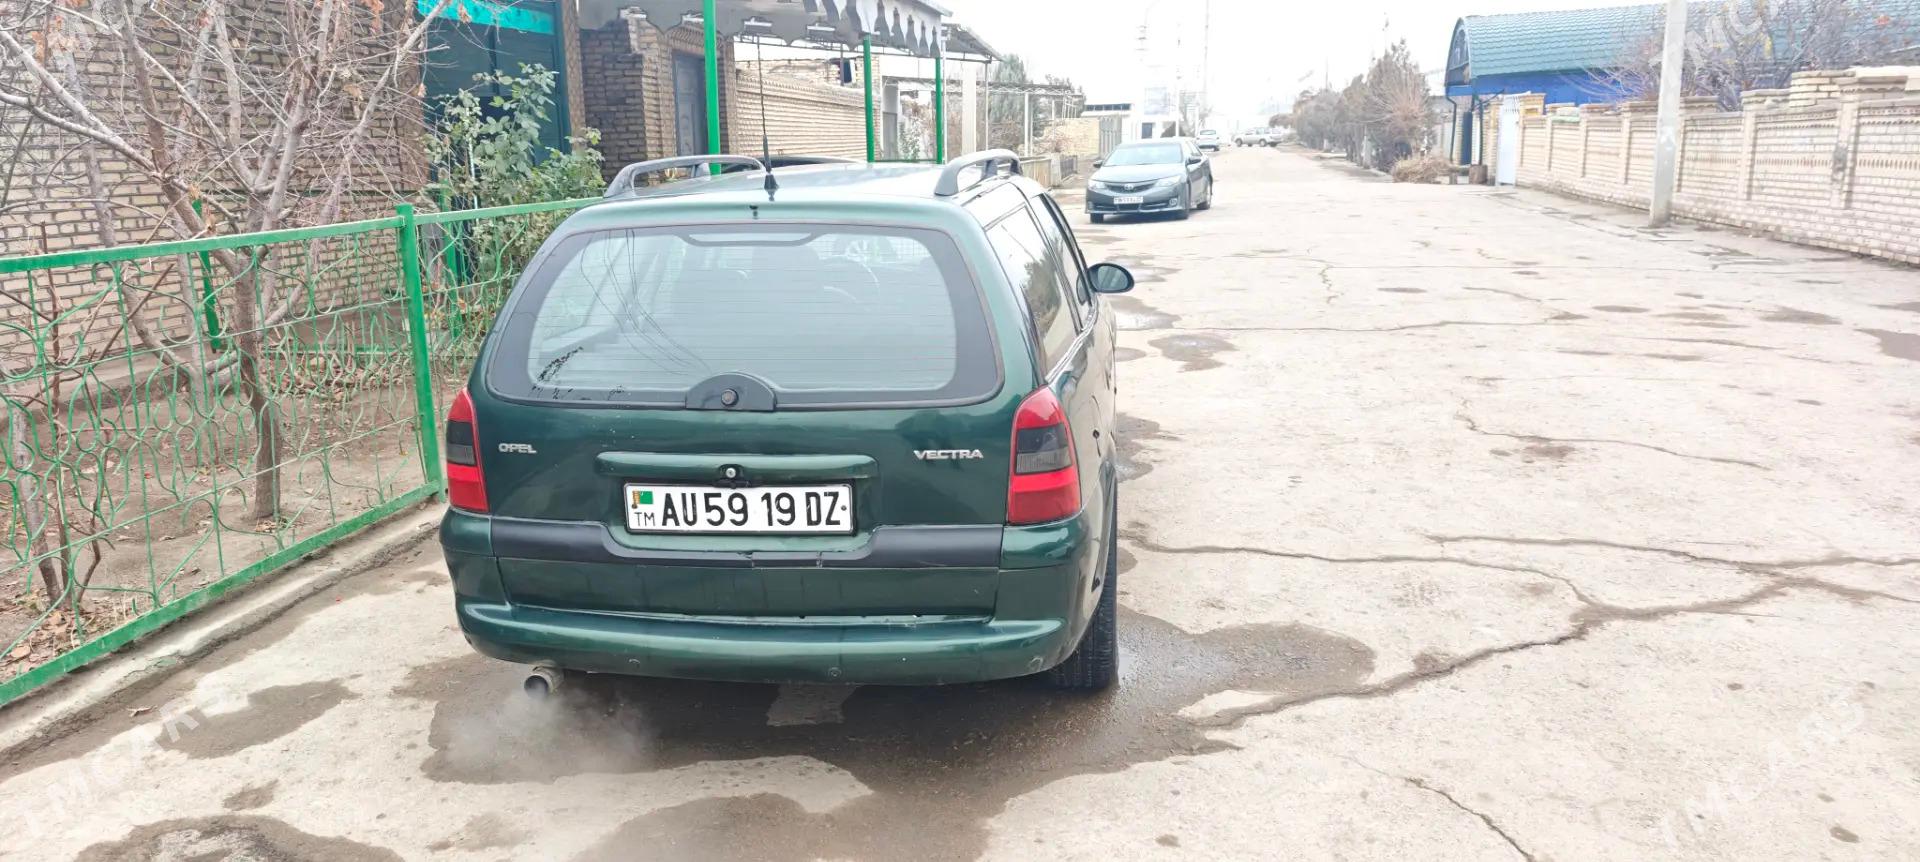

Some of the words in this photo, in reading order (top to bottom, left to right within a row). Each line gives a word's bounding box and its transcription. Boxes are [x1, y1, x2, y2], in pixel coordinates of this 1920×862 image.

[498, 443, 537, 453] OPEL
[913, 449, 984, 460] VECTRA
[661, 492, 698, 526] AU
[703, 492, 749, 527] 59
[761, 492, 796, 526] 19
[805, 491, 841, 526] DZ
[634, 511, 656, 527] TM
